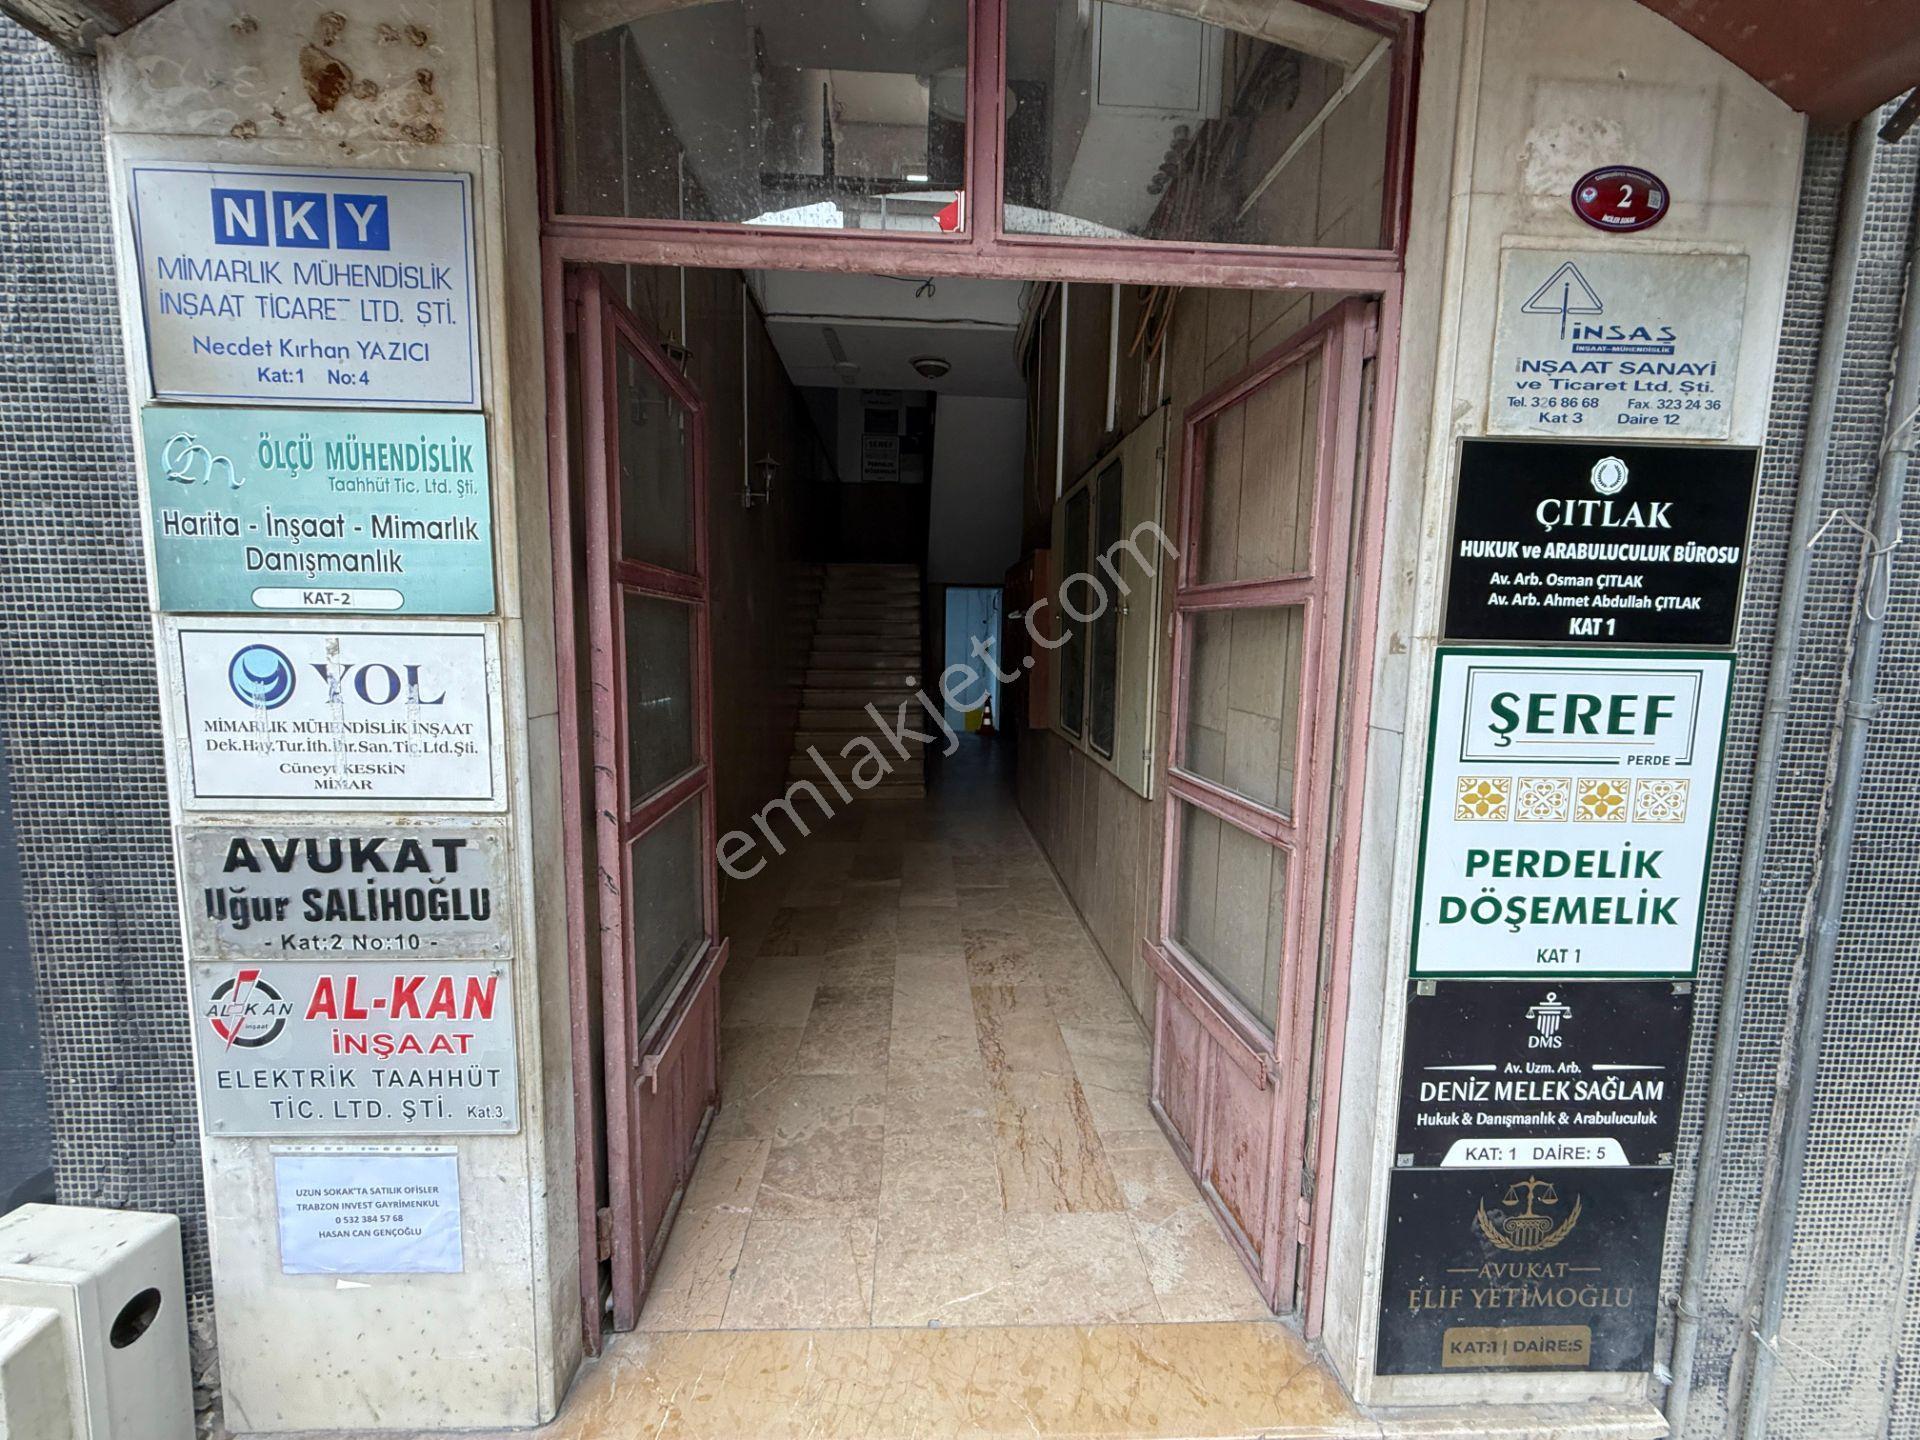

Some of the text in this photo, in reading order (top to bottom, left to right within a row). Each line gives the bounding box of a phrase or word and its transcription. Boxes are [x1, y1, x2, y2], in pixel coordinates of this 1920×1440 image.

[1617, 184, 1632, 207] 2
[222, 197, 378, 242] NKY
[158, 254, 452, 290] MİMARLIK MÜHENDİSLİK
[159, 289, 244, 320] İNŞAAT
[360, 300, 404, 323] LTD.
[417, 298, 456, 328] ŞTİ.
[193, 336, 429, 362] Necdet Kırhan YAZICI
[257, 367, 369, 385] Kat:1 No:4
[1516, 357, 1717, 376] İNŞAAT SANAYİ
[1516, 378, 1714, 396] ve Ticaret Ltd. Şti.
[1507, 397, 1599, 408] Tel. 326 86 68
[1657, 399, 1681, 410] 323
[1685, 400, 1701, 410] 24
[1705, 400, 1721, 410] 36
[1539, 413, 1583, 423] Kat 3
[1618, 414, 1680, 425] Daire 12
[258, 432, 474, 478] ÖLÇÜ MÜHENDİSLİK
[329, 476, 477, 497] Taahhüt Tic. Ltd. Şti.
[163, 510, 240, 537] Harita
[266, 506, 344, 544] İnşaat
[372, 515, 479, 540] Mimarlık
[1536, 499, 1673, 532] ÇITLAK
[1460, 540, 1739, 563] HUKUK ve ARABULUCULUK BÜROSU
[246, 547, 403, 579] Danışmanlık
[1490, 573, 1643, 589] Av. Arb. Osman ÇITLAK
[303, 592, 350, 605] KAT-2
[1488, 593, 1700, 611] Av. Arb. Ahmet Abdullah ÇITLAK
[1569, 618, 1615, 635] KAT 1
[310, 663, 447, 705] YOL
[205, 717, 473, 738] MİMARLIK MÜHENDİSLİK İNŞAAT
[1488, 692, 1676, 747] ŞEREF
[344, 761, 405, 774] KESKİN
[1627, 755, 1670, 765] PERDE
[223, 838, 467, 873] AVUKAT
[1465, 841, 1664, 879] PERDELİK
[205, 876, 491, 930] Uğur SALİHOĞLU
[1439, 887, 1680, 933] DÖŞEMELİK
[281, 934, 342, 950] Kat:2
[353, 934, 420, 950] No:10
[1537, 949, 1581, 963] KAT 1
[305, 976, 499, 1020] AL-KAN
[333, 1029, 475, 1059] İNŞAAT
[1528, 1036, 1562, 1048] DMS
[217, 1065, 501, 1089] ELEKTRİK TAAHHÜT
[1504, 1062, 1582, 1074] Av. Uzm. Arb.
[1420, 1076, 1664, 1102] DENİZ MELEK SAĞLAM
[270, 1095, 503, 1123] TİC. LTD. ŞTİ. Kat.3
[1416, 1111, 1657, 1128] Hukuk & Danışmanlık & Arabuluculuk
[1466, 1144, 1606, 1160] KAT: 1 DAİRE: 5
[296, 1189, 322, 1197] UZUN
[370, 1187, 401, 1195] SATILIK
[404, 1185, 439, 1194] OFİSLER
[297, 1203, 339, 1211] TRABZON
[375, 1199, 440, 1209] GAYRİMENKUL
[343, 1216, 359, 1224] 532
[319, 1227, 422, 1238] HASAN CAN GENÇOĞLU
[1479, 1263, 1568, 1278] AVUKAT
[1409, 1284, 1633, 1309] ELİF YETİMOĞLU
[1451, 1340, 1497, 1354] KAT:1
